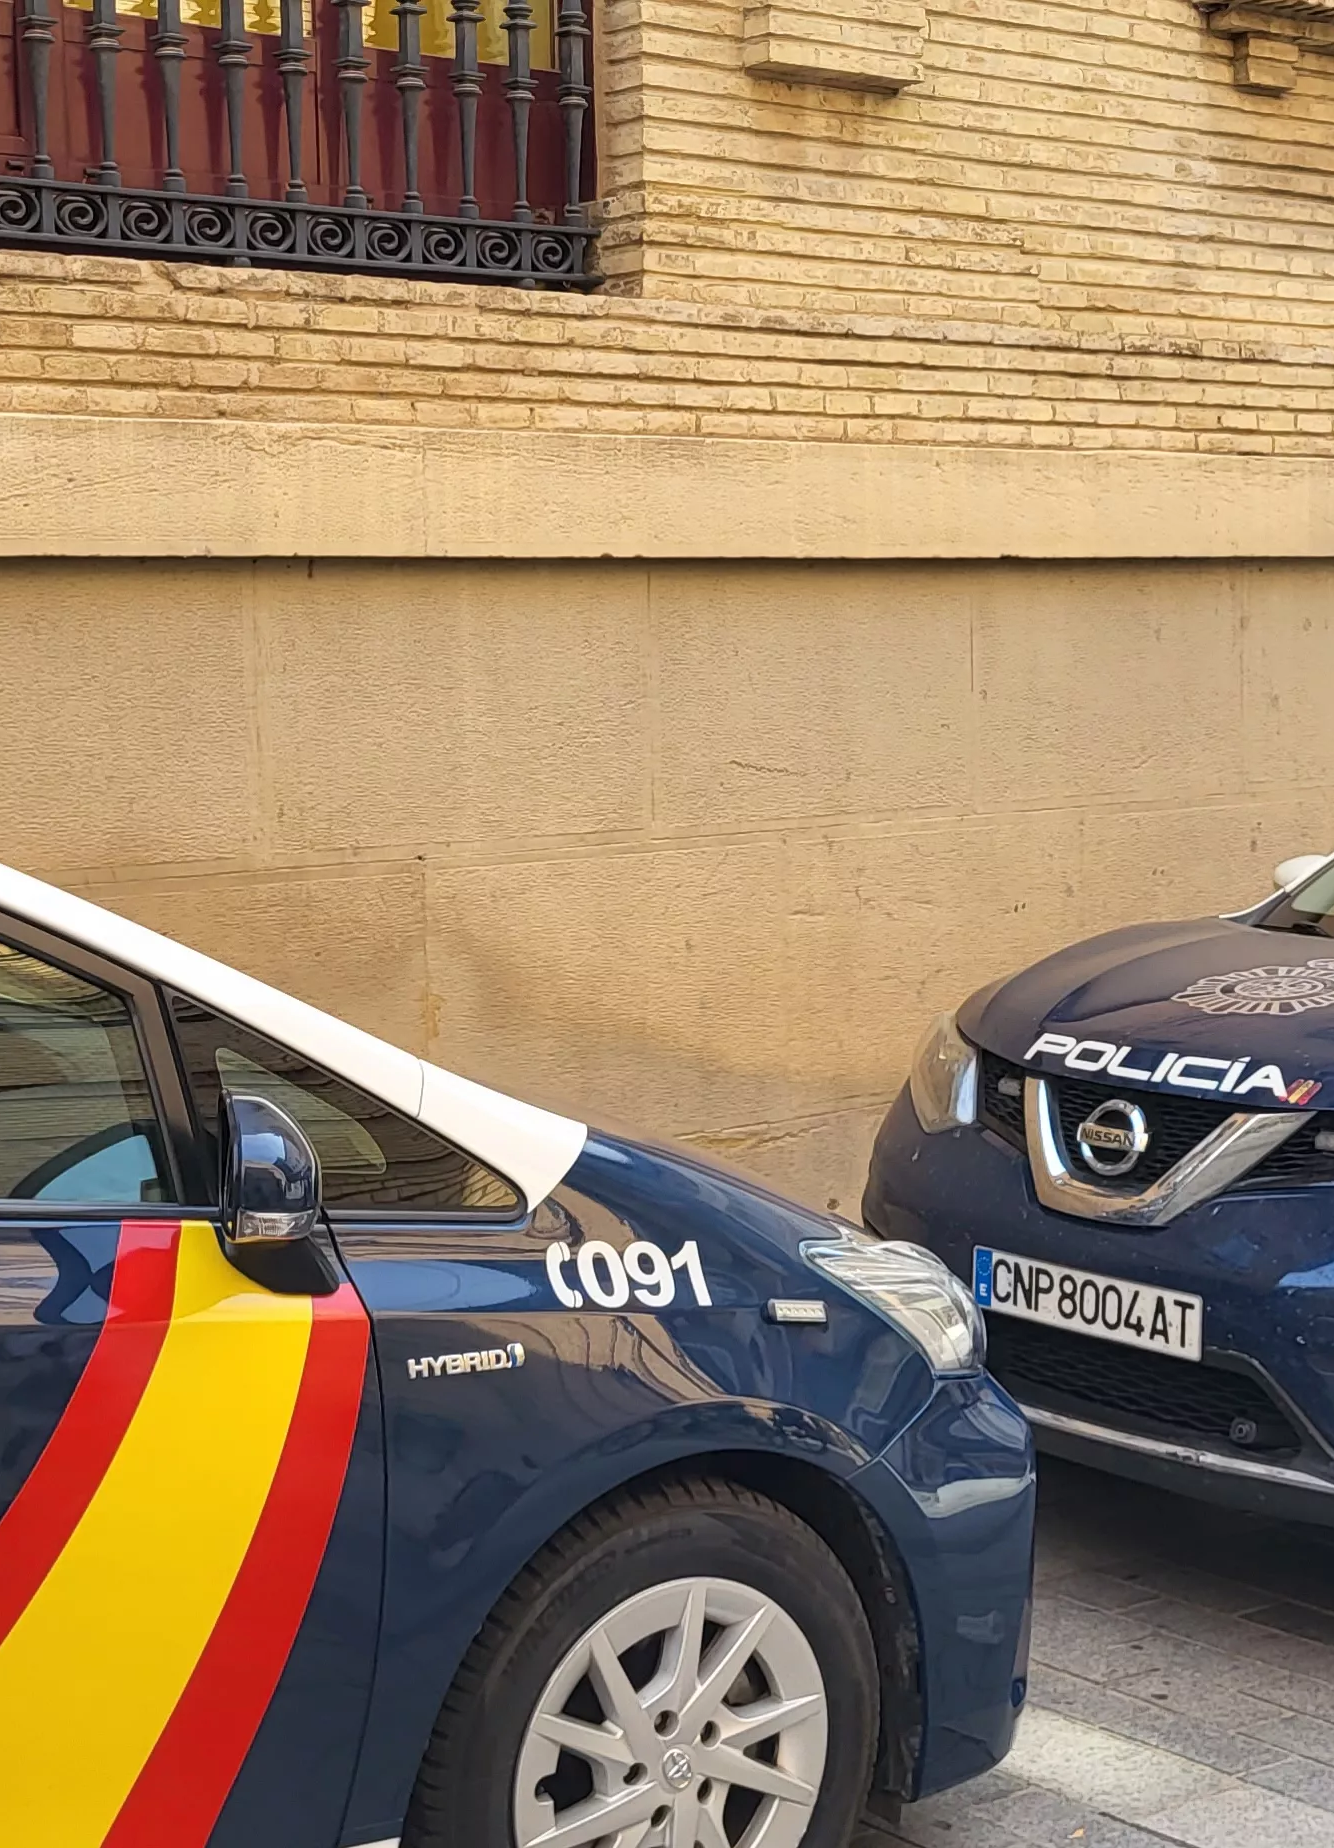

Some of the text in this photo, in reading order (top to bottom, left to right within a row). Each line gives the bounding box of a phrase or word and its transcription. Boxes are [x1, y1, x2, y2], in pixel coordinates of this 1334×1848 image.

[1024, 1032, 1287, 1098] POLICÍA
[1082, 1127, 1134, 1147] NISSAN
[979, 1283, 988, 1297] E
[407, 1349, 507, 1379] HYBRID
